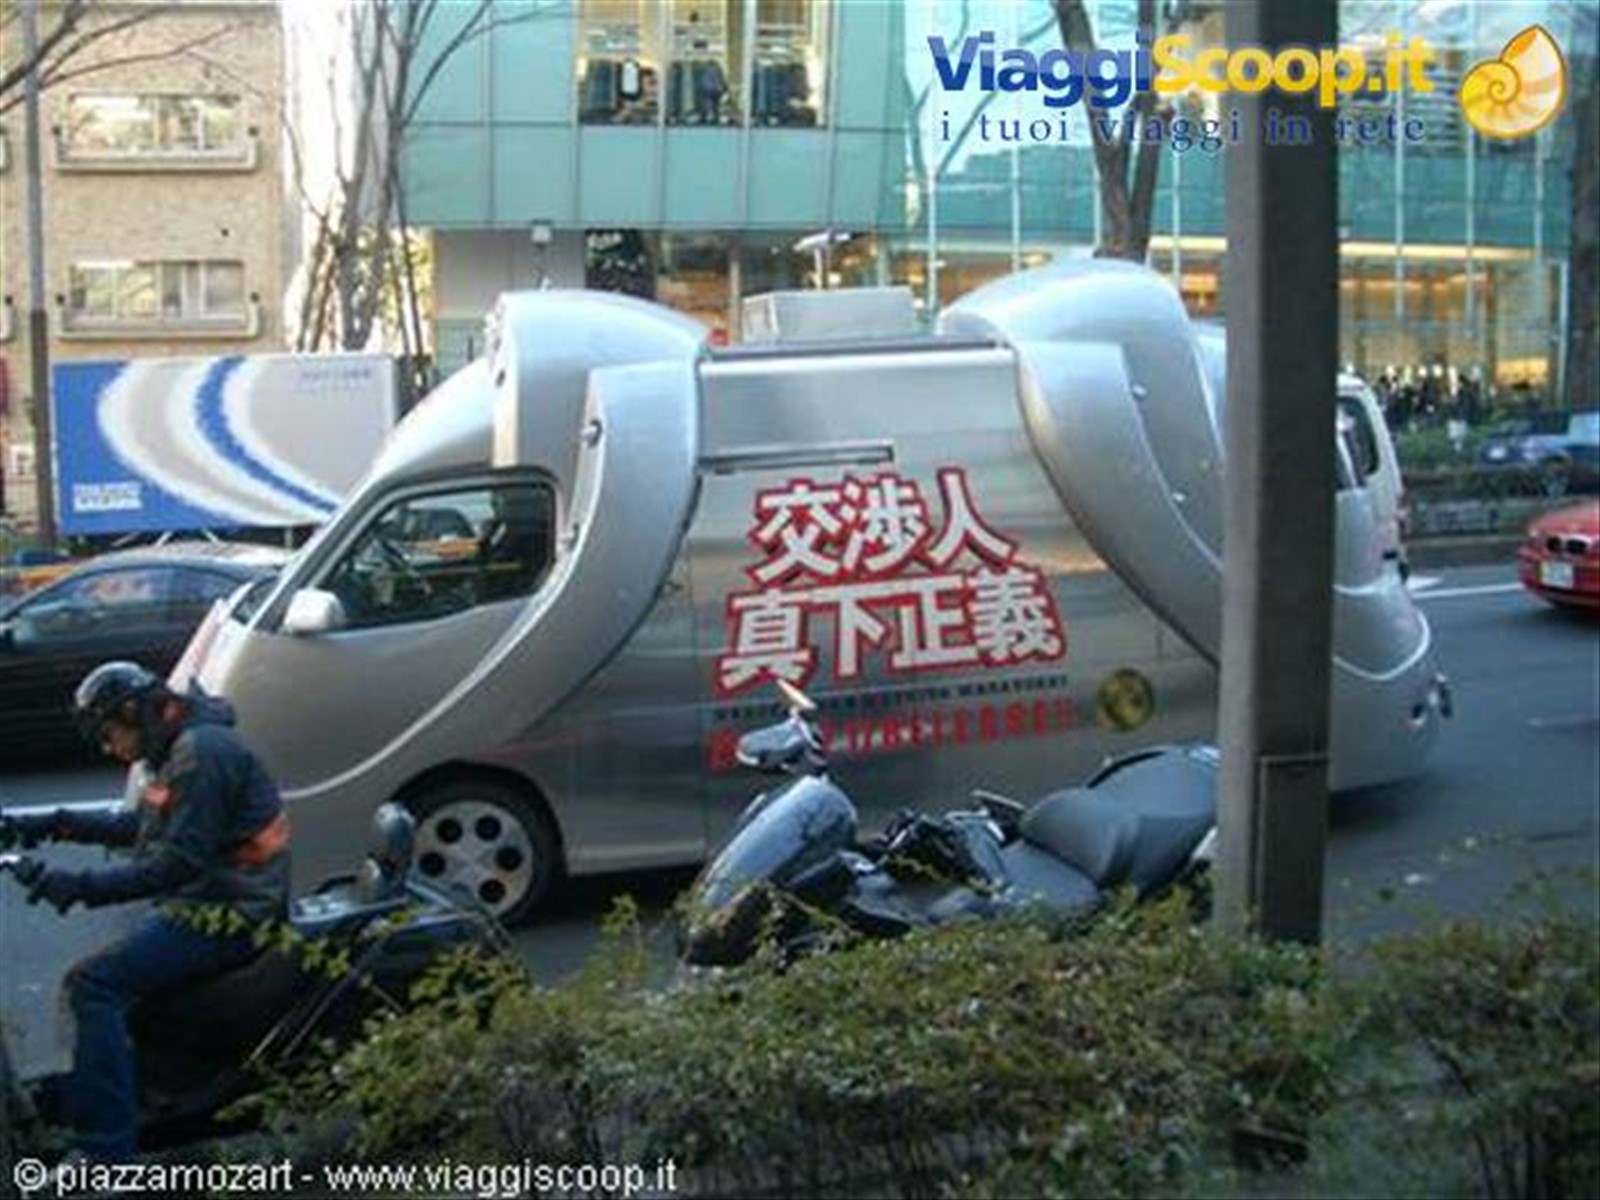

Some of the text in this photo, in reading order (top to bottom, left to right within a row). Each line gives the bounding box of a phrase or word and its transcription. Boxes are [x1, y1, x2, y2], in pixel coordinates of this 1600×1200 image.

[750, 469, 1016, 585] 交渉人
[717, 566, 1065, 693] 真下正義
